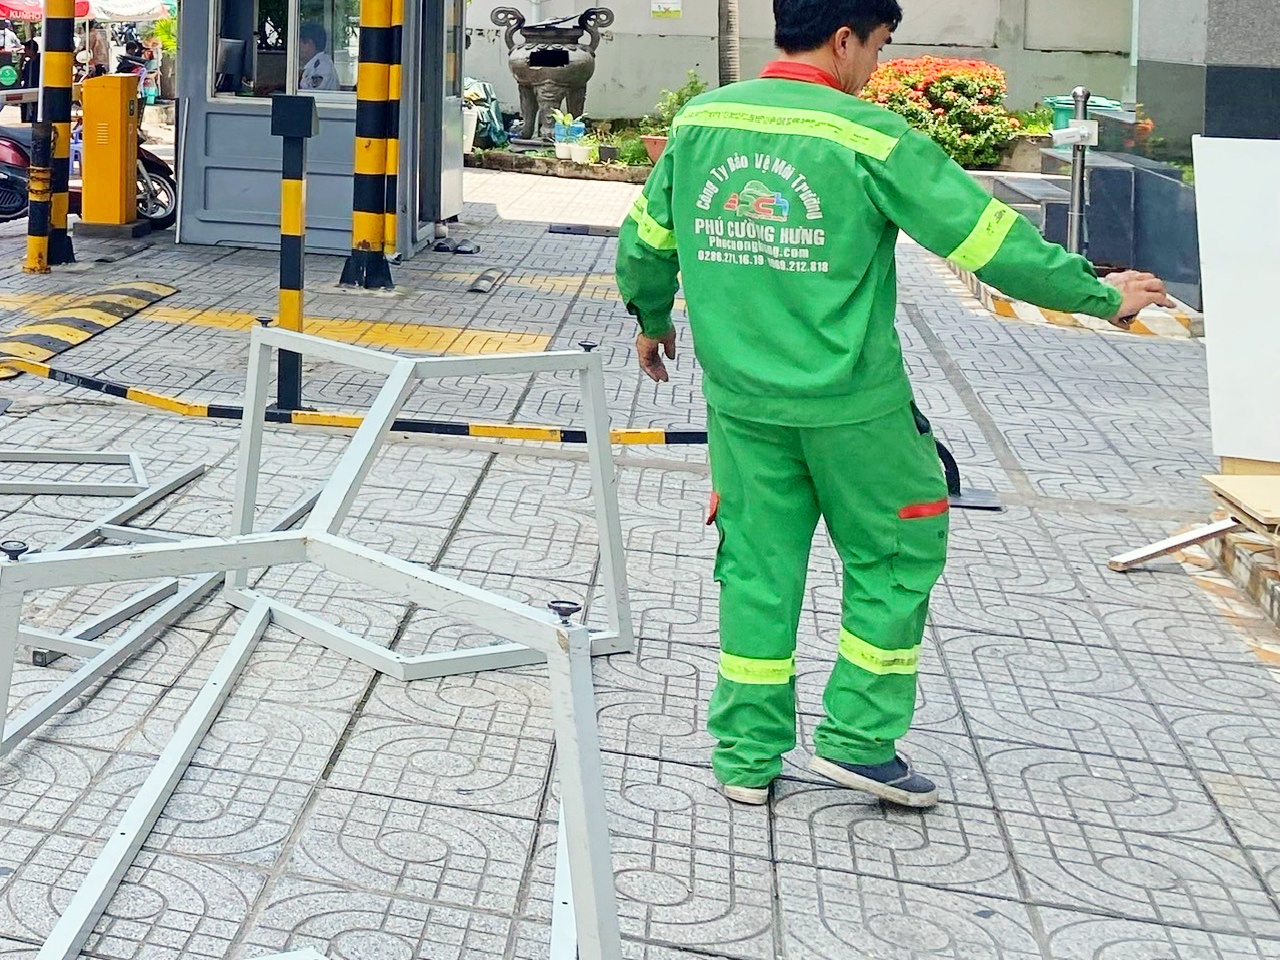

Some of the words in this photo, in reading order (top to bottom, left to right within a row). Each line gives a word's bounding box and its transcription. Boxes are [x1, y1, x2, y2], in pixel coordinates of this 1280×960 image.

[9, 10, 43, 21] KUMHO
[710, 165, 729, 182] Ty
[694, 216, 724, 236] PHÚ
[780, 225, 826, 246] HƯNG
